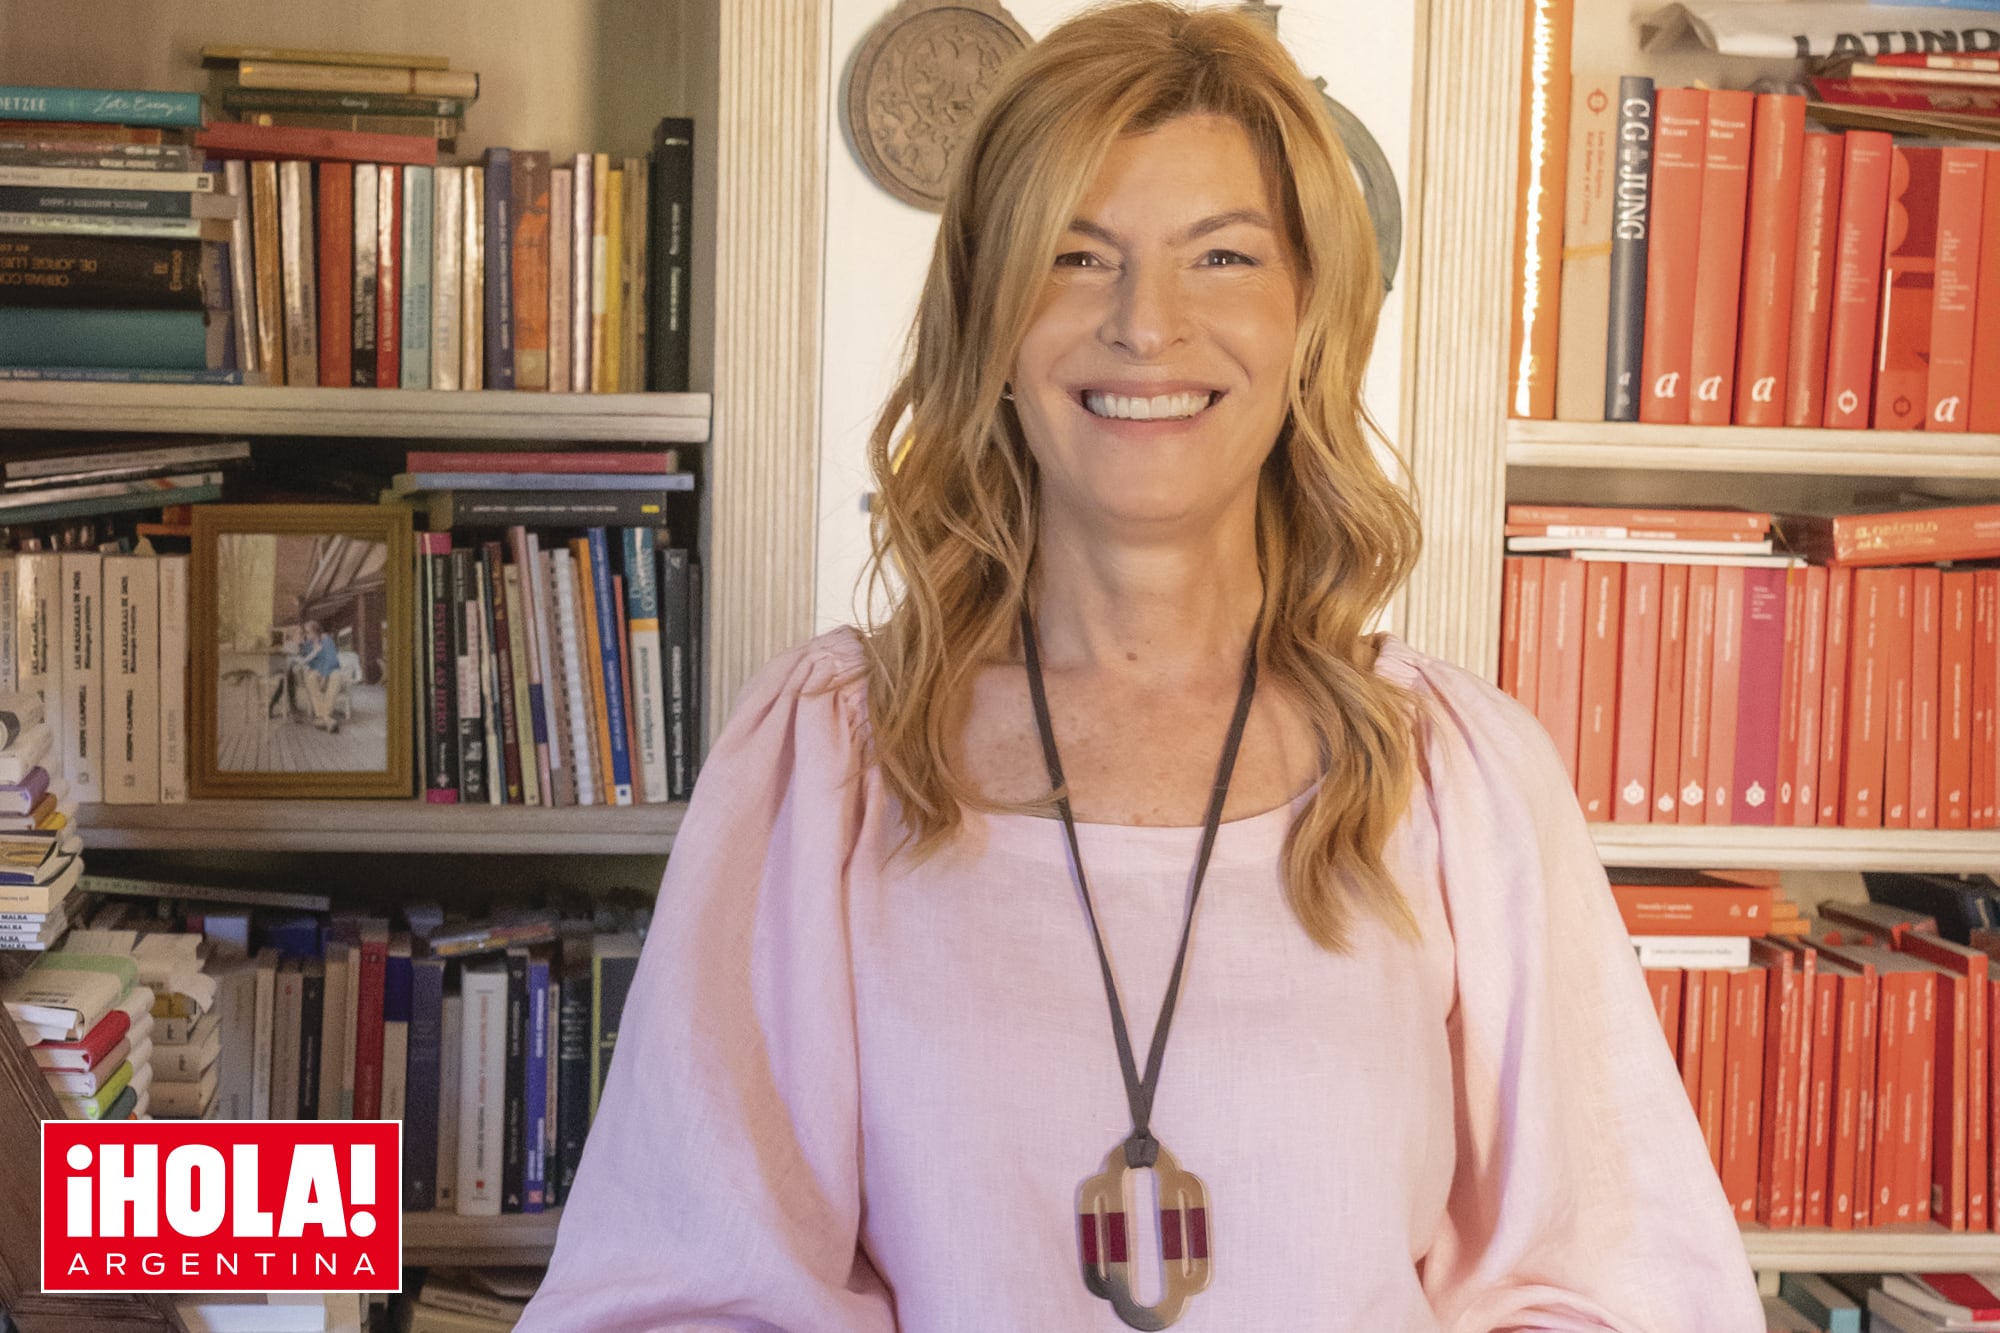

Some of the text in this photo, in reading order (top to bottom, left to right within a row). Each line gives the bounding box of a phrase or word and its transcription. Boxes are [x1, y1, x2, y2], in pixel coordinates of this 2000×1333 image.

[1617, 98, 1649, 240] C G JUNG
[435, 603, 446, 663] PSYCHE
[436, 668, 446, 685] AS
[436, 689, 447, 733] HERO
